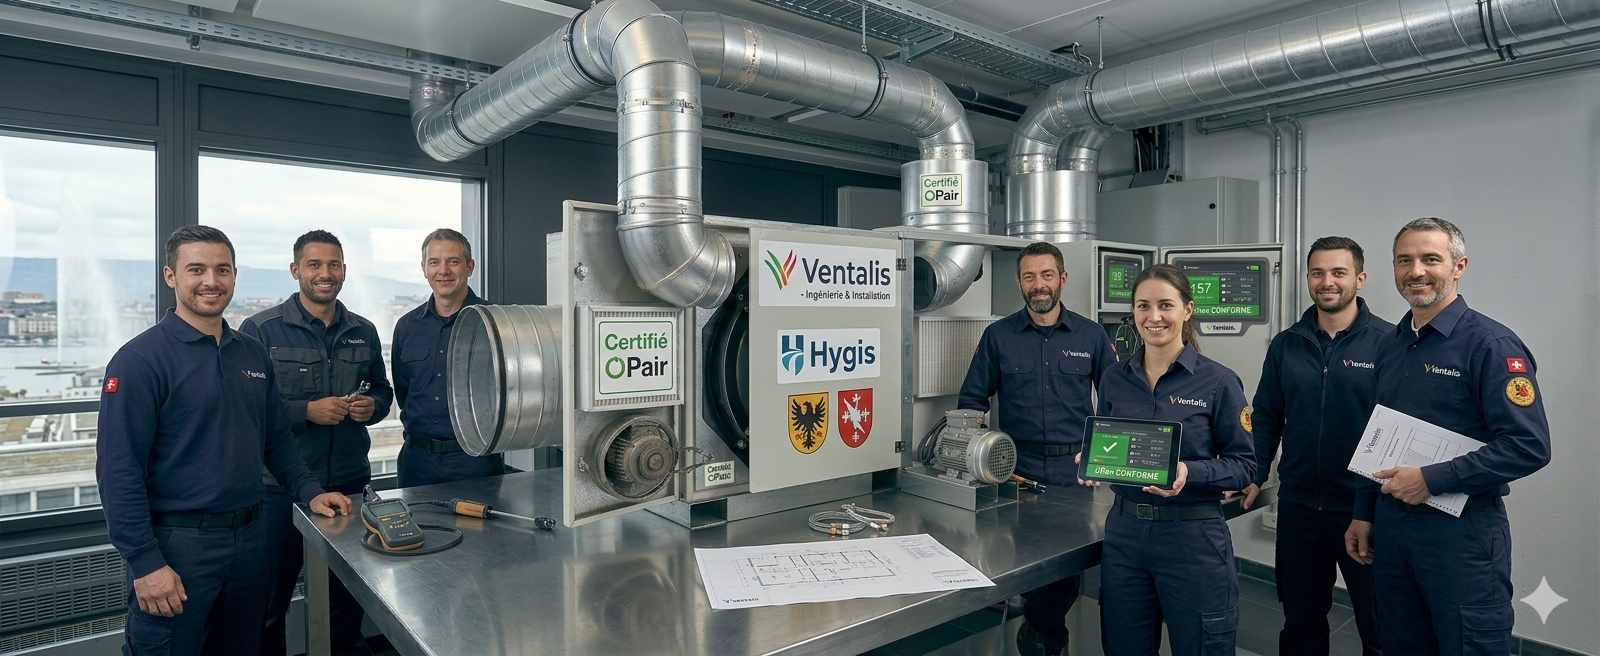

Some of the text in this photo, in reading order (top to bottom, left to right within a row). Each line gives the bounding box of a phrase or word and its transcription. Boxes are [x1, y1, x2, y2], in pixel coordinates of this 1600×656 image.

[801, 257, 891, 286] Ventalis
[845, 290, 850, 299] &
[604, 332, 668, 351] Certifié
[810, 339, 876, 374] Hygis
